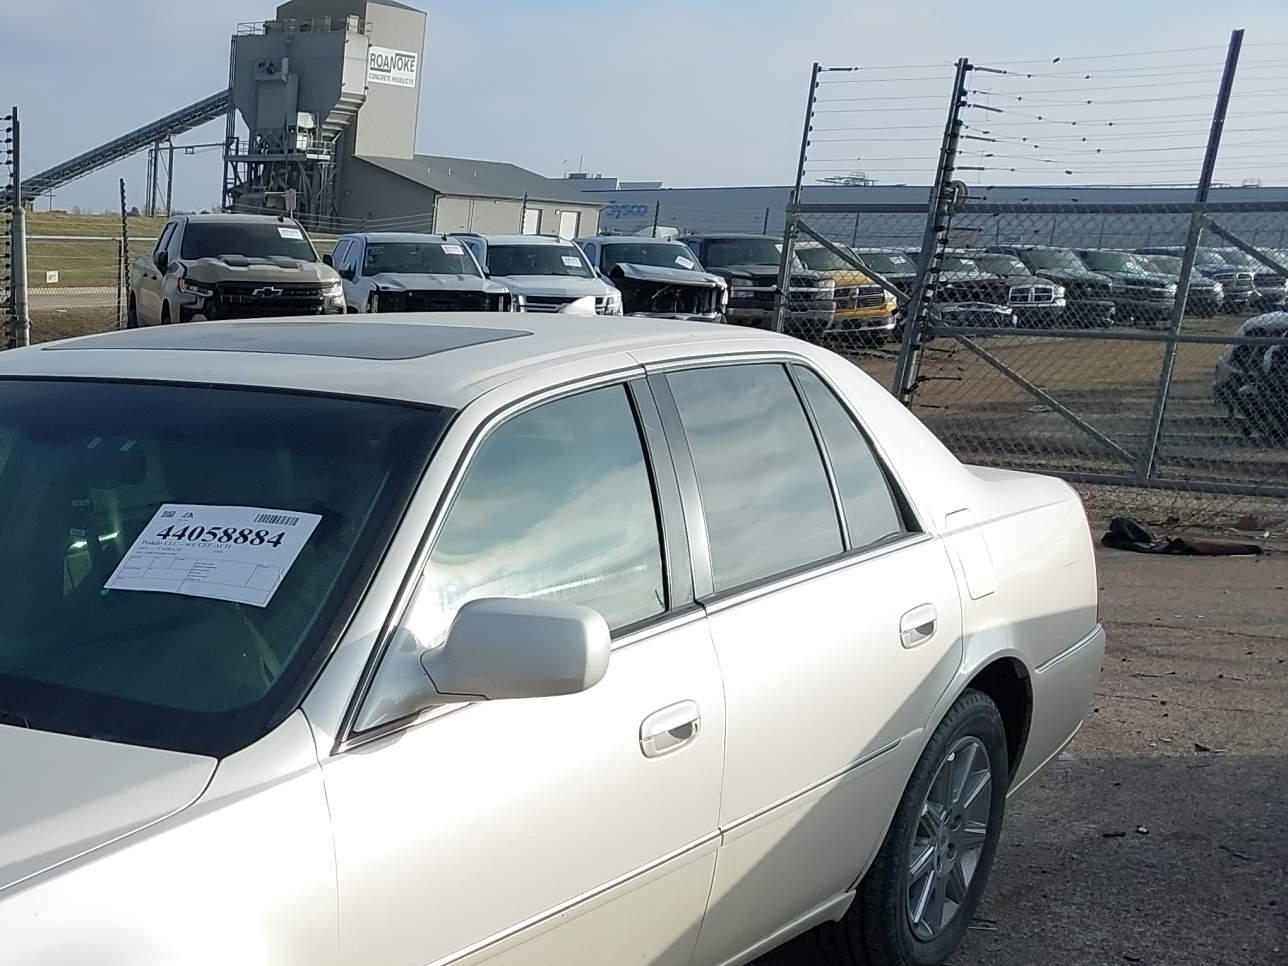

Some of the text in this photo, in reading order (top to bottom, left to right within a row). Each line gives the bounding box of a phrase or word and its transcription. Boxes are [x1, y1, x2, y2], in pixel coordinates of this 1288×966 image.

[369, 52, 416, 73] ROANOKE
[368, 72, 414, 85] CONCRETE PRODUCTS
[156, 524, 287, 549] 44058884
